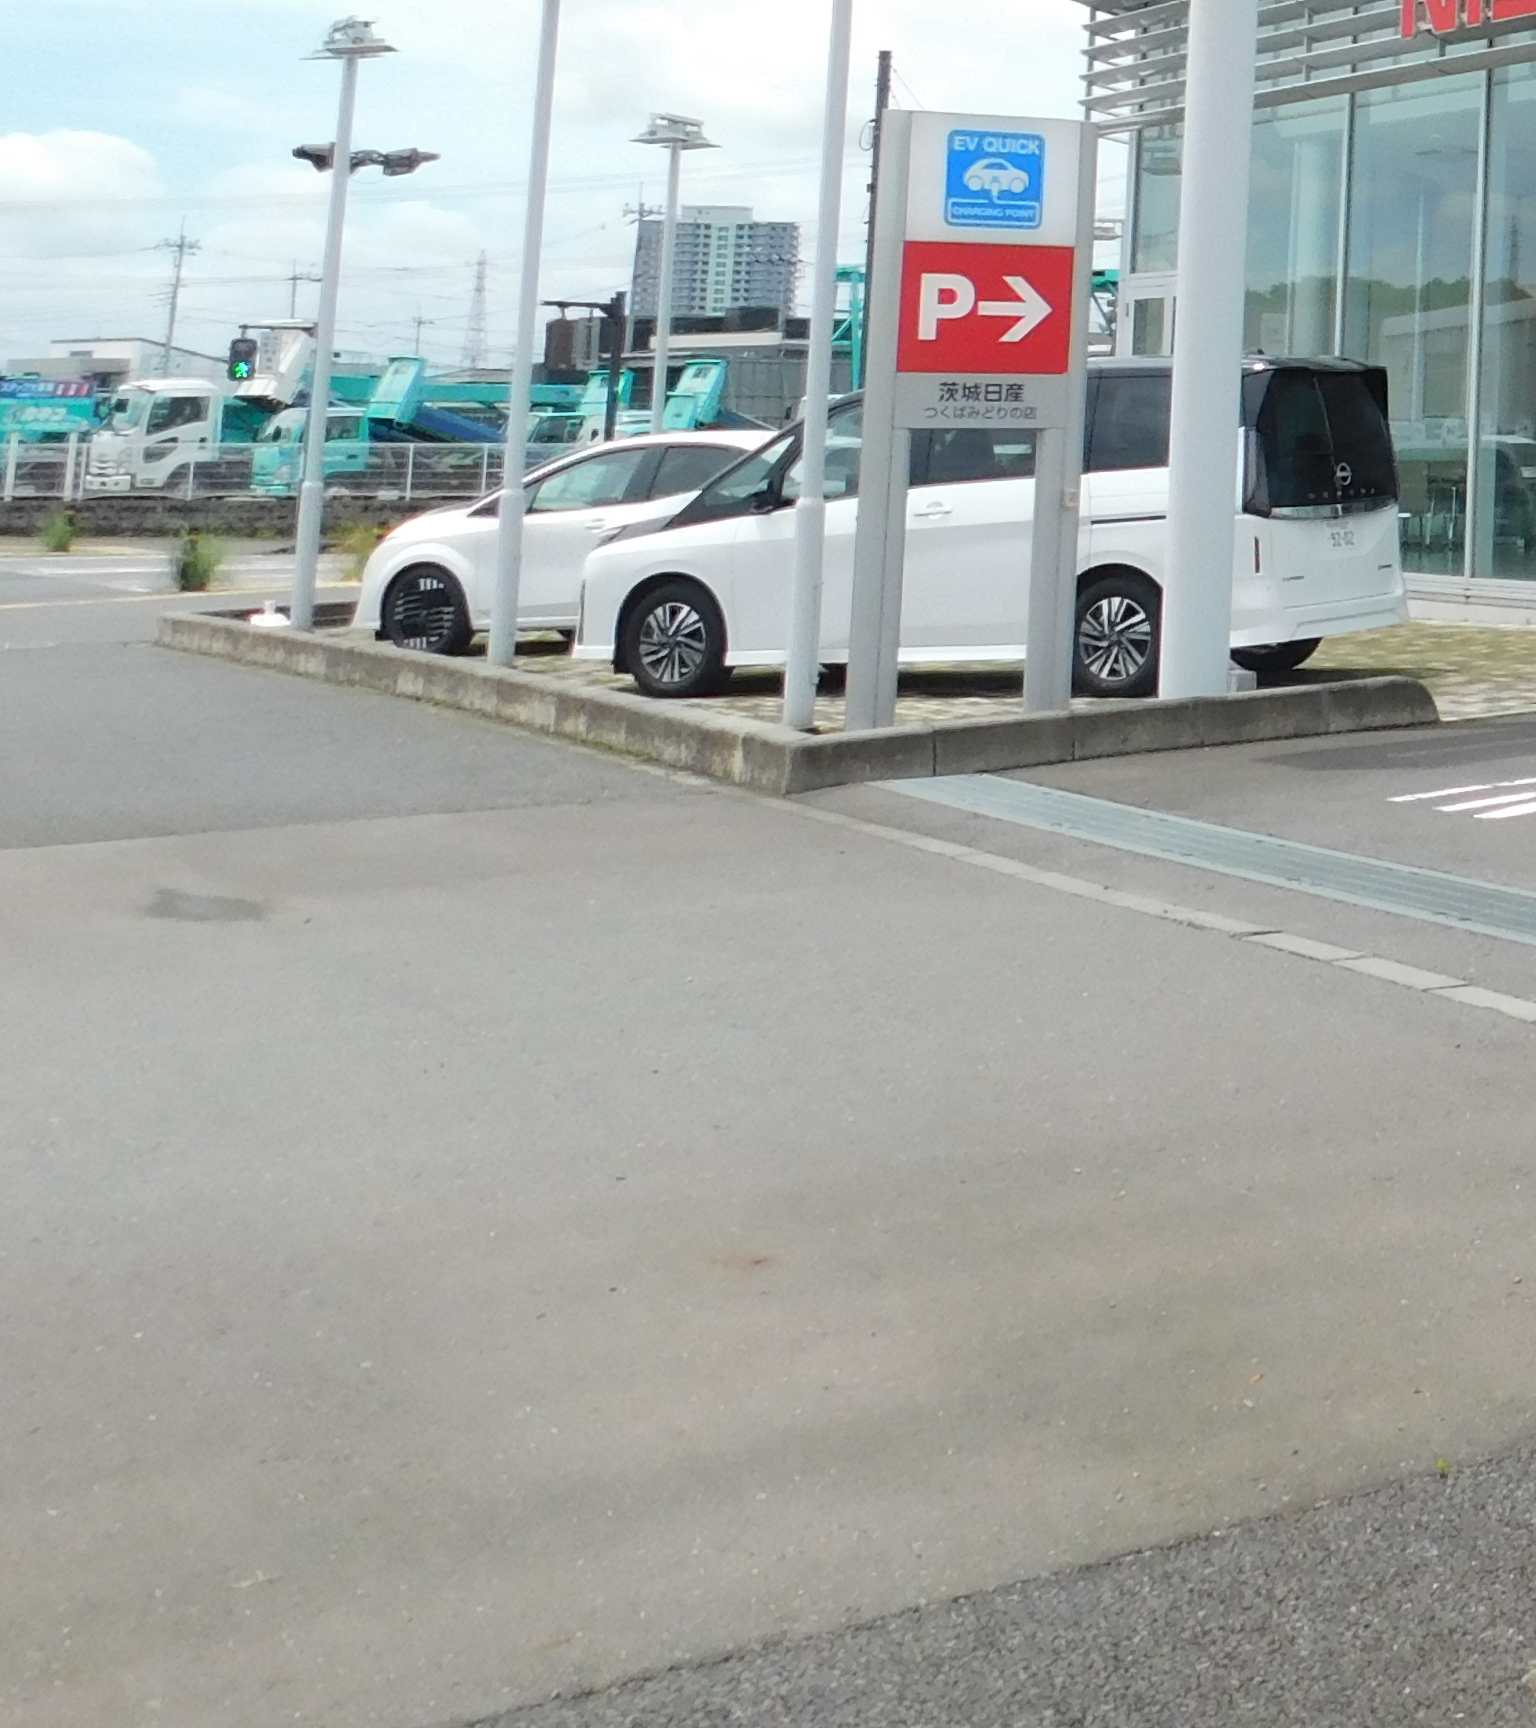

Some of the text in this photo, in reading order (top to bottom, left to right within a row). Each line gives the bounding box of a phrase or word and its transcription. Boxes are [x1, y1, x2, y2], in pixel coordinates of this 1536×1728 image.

[953, 136, 1040, 154] EV QUICK
[953, 206, 1034, 218] CHARGING POINT
[918, 274, 976, 341] P
[938, 381, 1025, 403] 茨城日産
[923, 406, 1038, 420] つくばみどりの店
